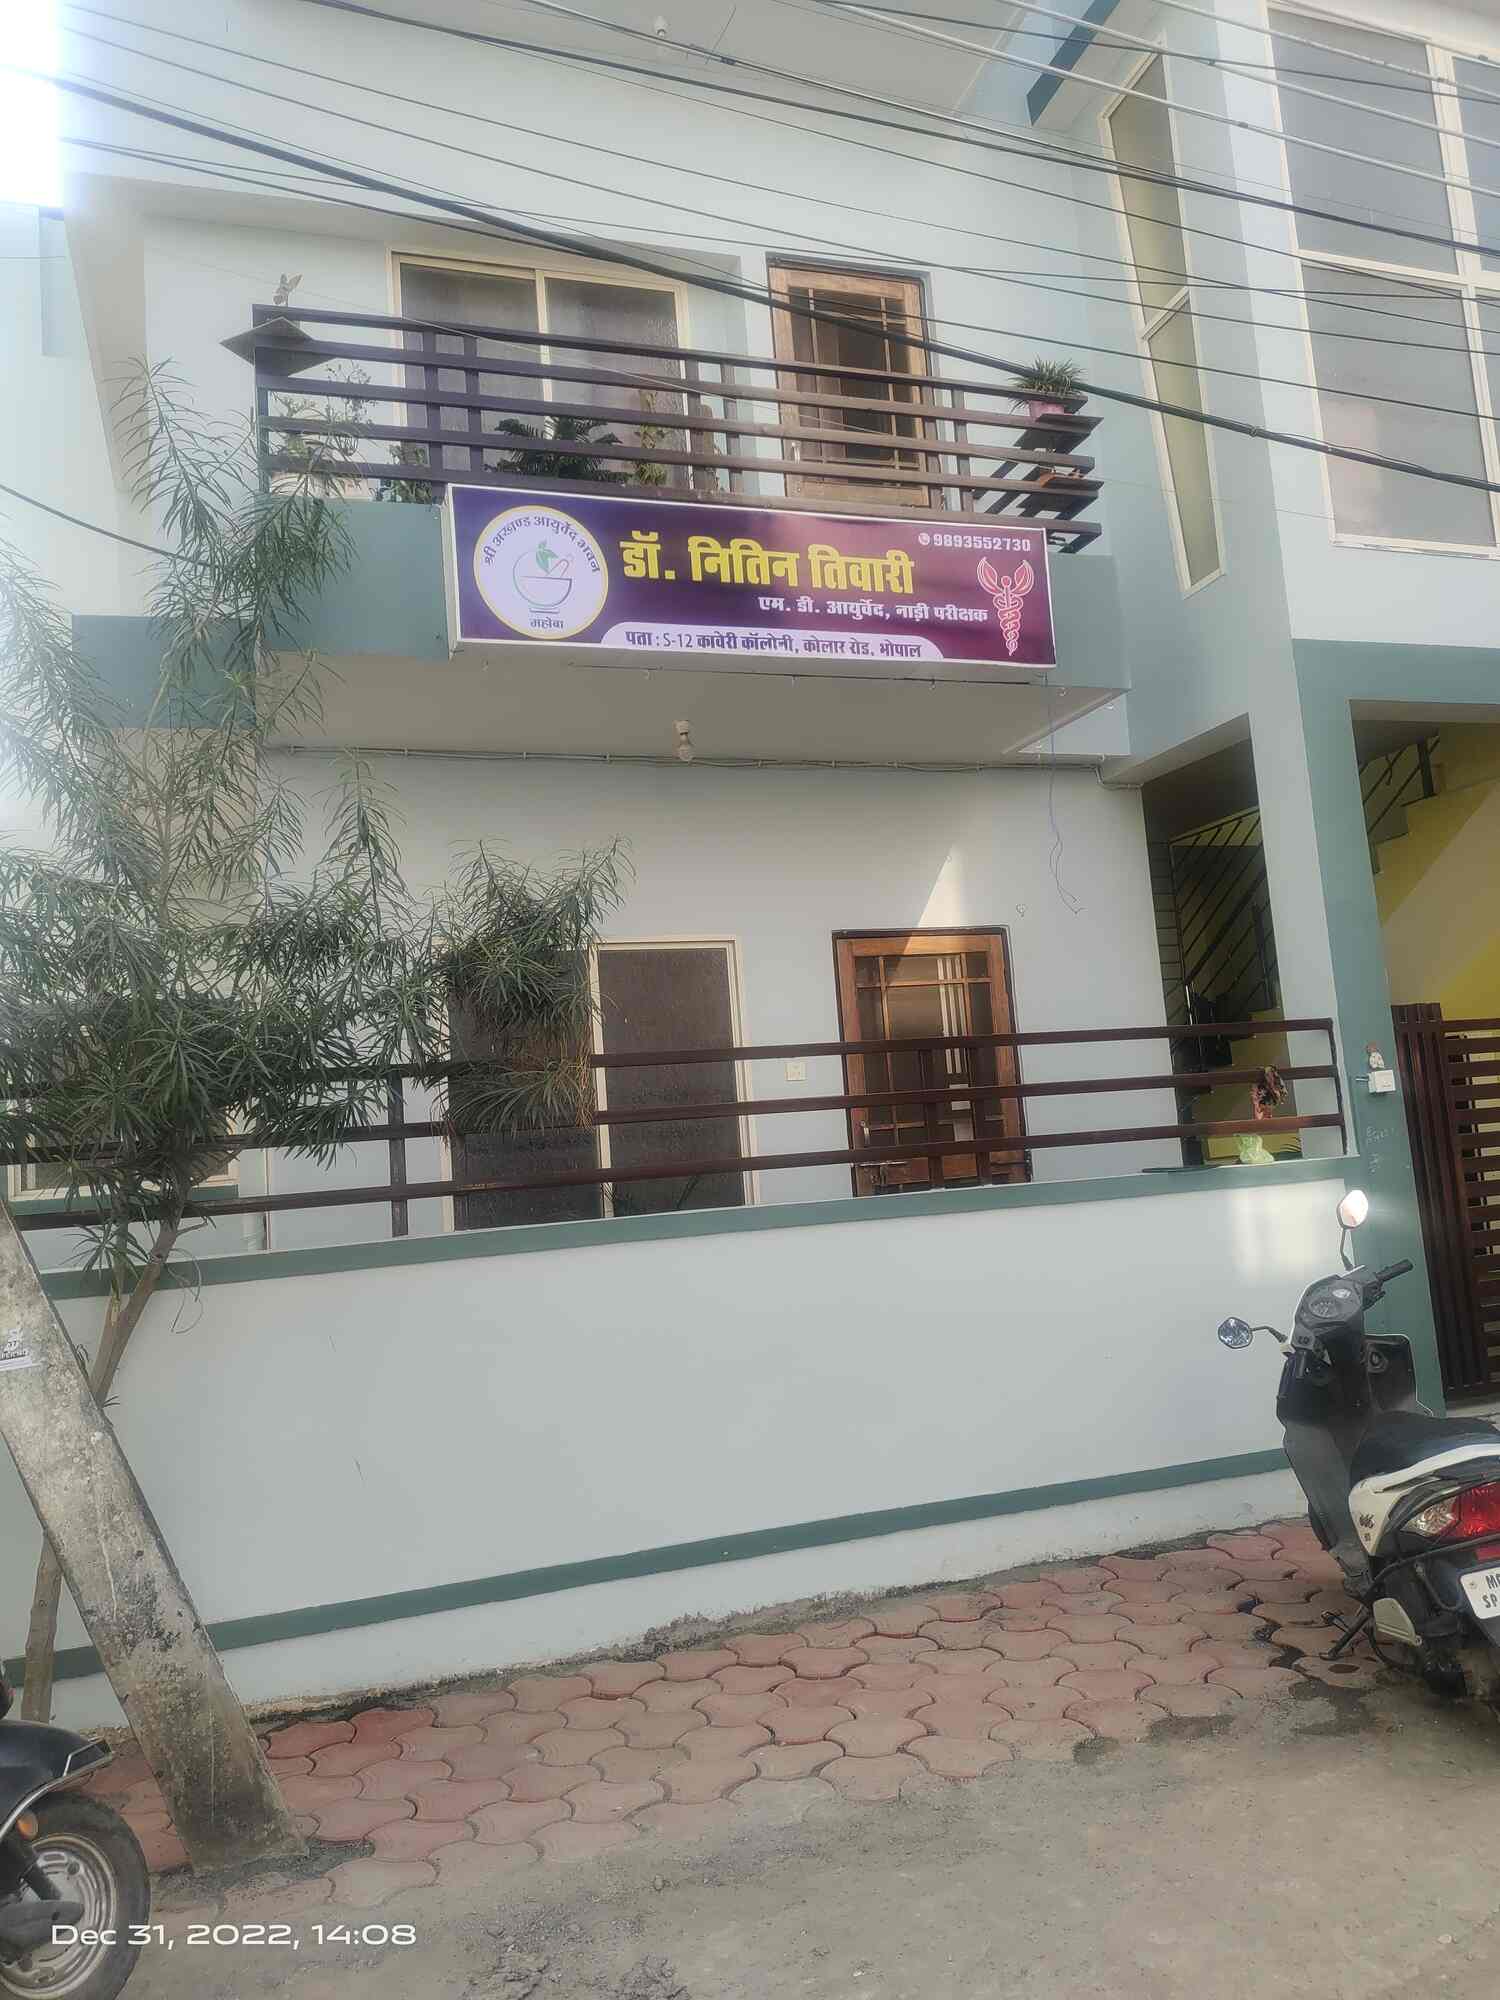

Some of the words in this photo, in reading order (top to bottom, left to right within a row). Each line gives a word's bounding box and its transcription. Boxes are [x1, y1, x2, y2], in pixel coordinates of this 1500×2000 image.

[483, 545, 497, 566] श्री
[534, 516, 577, 541] आयुर्वेद
[933, 533, 1031, 552] 9893552730
[619, 530, 676, 580] डॉ.
[687, 535, 800, 587] नितिन
[808, 543, 915, 594] तिवारी
[757, 596, 790, 612] एम.
[796, 595, 819, 613] डी.
[826, 598, 890, 620] आयुर्वेद,
[896, 602, 929, 622] नाड़ी
[934, 603, 989, 622] परीक्षक
[625, 631, 653, 646] पता
[663, 632, 693, 649] S-12
[696, 631, 738, 649] कावेरी
[741, 632, 799, 653] कॉलोनी,
[802, 635, 845, 654] कोलार
[879, 639, 921, 657] भोपाल
